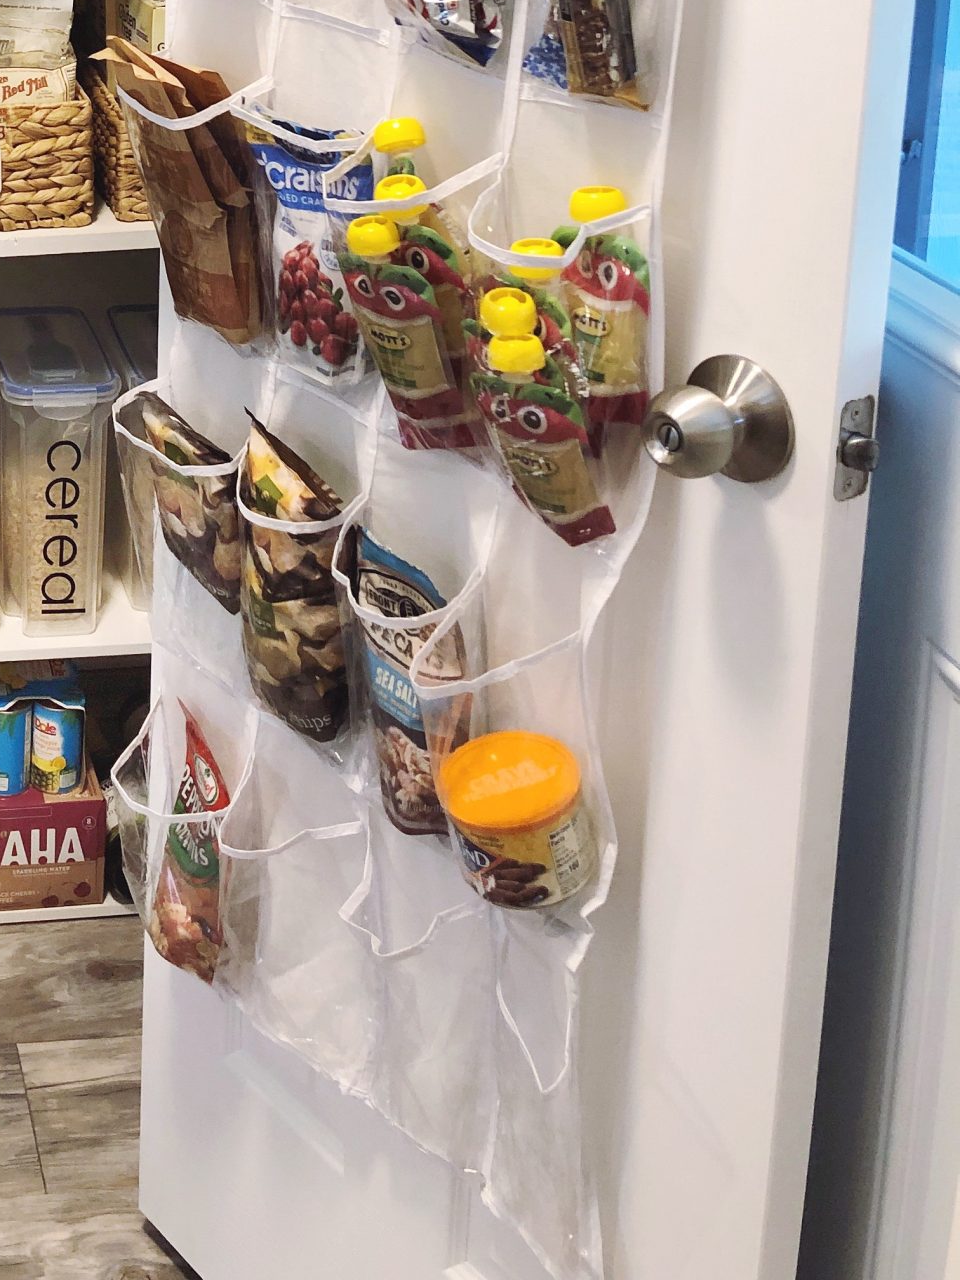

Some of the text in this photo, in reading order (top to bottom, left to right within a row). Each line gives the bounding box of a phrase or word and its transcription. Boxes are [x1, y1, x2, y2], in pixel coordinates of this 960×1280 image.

[1, 76, 49, 101] Red Mill
[370, 330, 407, 347] MOTT'S
[39, 438, 87, 616] cereal
[368, 589, 396, 613] FRONT
[375, 666, 395, 692] SEA
[34, 718, 57, 734] Dole
[0, 826, 86, 867] AHA
[12, 867, 48, 876] SPARKLING
[10, 890, 36, 898] CHERRY
